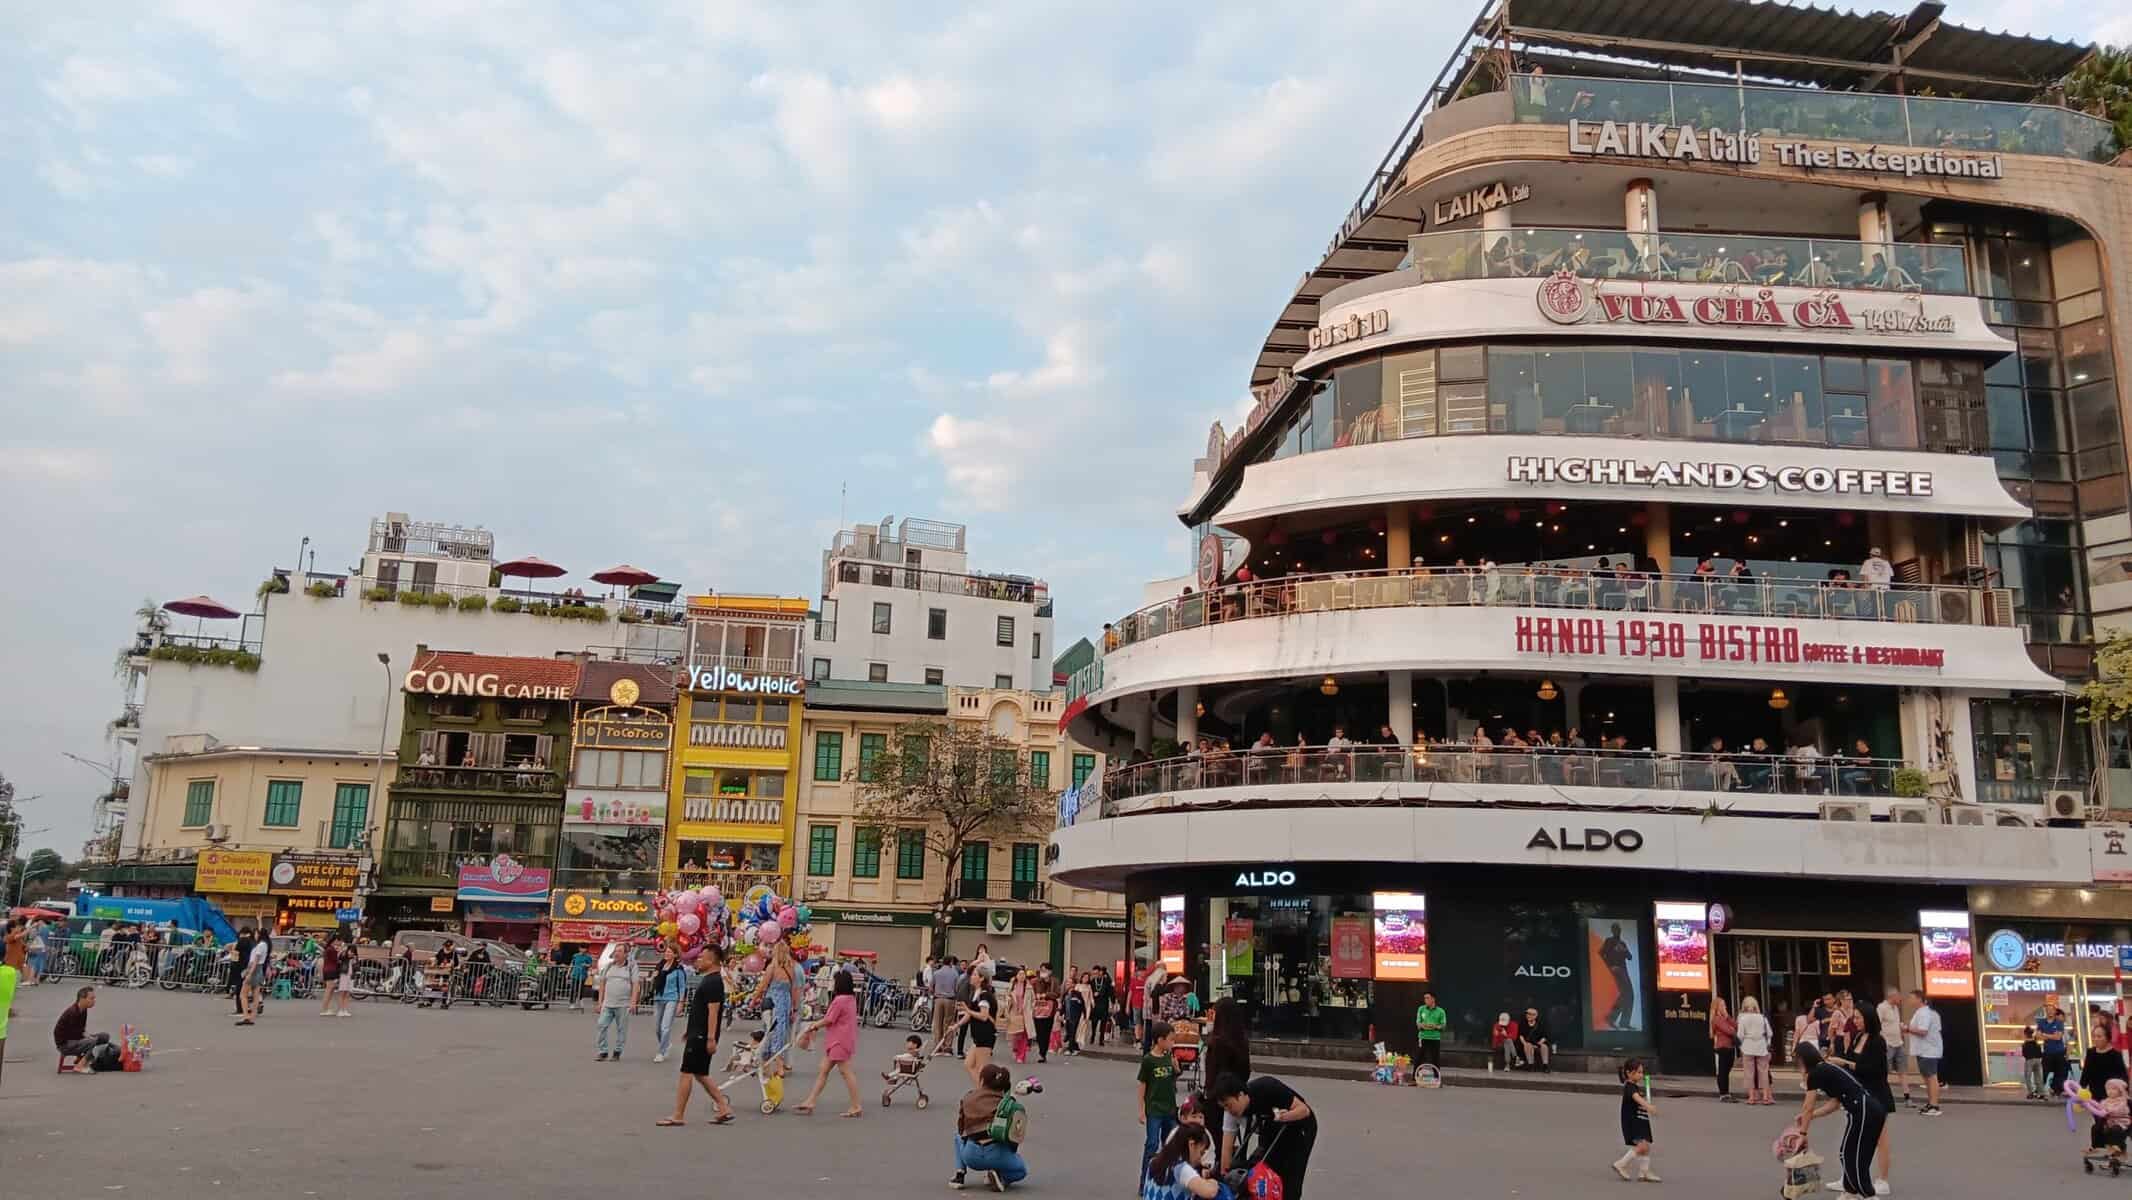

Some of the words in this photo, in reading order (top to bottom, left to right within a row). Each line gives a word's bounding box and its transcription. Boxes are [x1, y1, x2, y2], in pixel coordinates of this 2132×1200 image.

[1569, 118, 1703, 160] LAIKA
[1709, 126, 1761, 165] Café
[1773, 143, 1829, 168] The
[1835, 146, 2003, 179] Exceptional
[1433, 182, 1510, 226] LAIKA
[1600, 294, 1689, 323] VUA
[1693, 289, 1788, 326] CHẢ
[1792, 292, 1855, 329] CÁ
[1507, 456, 1768, 489] HIGHLANDS
[1775, 466, 1933, 497] COFFEE
[1515, 615, 1606, 655] HANOI
[1616, 619, 1686, 659] 1930
[1699, 623, 1800, 664] BISTRO
[1802, 643, 1849, 664] COFFEE
[1852, 646, 1863, 664] &
[1865, 646, 1945, 667] RESTAURANT
[404, 665, 500, 699] CỘNG
[1526, 826, 1644, 853] ALDO
[296, 865, 320, 875] PATE
[1235, 871, 1297, 887] ALDO
[288, 898, 317, 908] PATE
[841, 911, 895, 922] Vietcombank
[1096, 919, 1127, 929] Vietcom
[2026, 942, 2066, 957] HOME
[2075, 944, 2114, 959] MADE
[1514, 965, 1572, 978] ALDO
[1993, 975, 2057, 992] 2Cream
[1680, 993, 1692, 1009] 1
